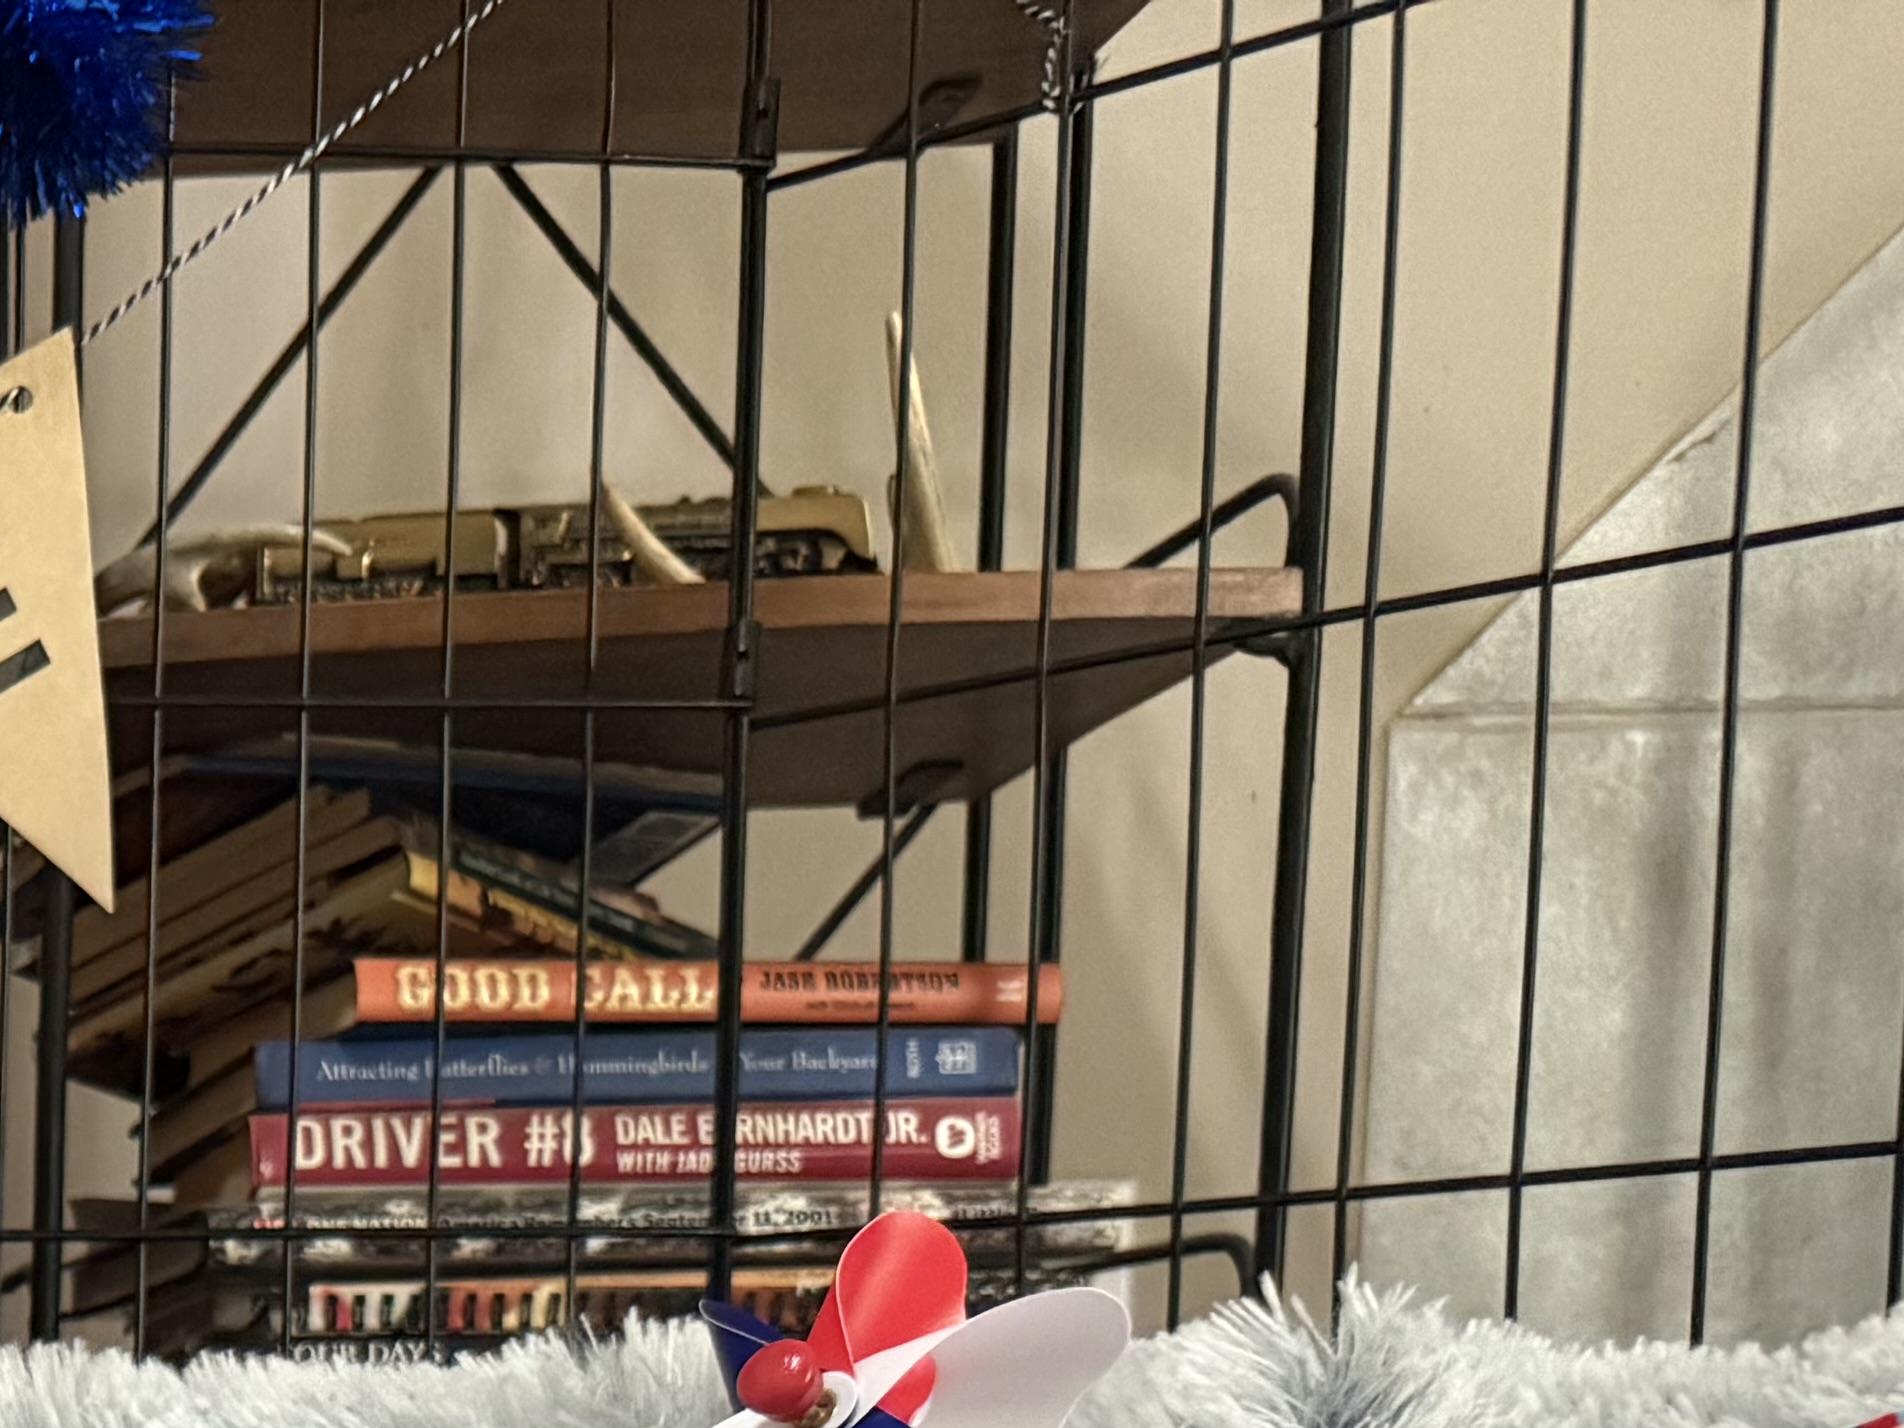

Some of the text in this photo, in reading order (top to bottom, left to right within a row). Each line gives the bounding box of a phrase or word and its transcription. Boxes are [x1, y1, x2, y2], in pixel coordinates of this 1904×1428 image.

[397, 965, 551, 1013] GOOD
[317, 1059, 419, 1082] Attracting
[739, 1051, 786, 1071] Your
[295, 1112, 594, 1171] DRIVER #8
[614, 1109, 928, 1146] DALE ERNHARDT JR.
[616, 1148, 672, 1174] WITH
[675, 1149, 715, 1174] JAD
[522, 1214, 633, 1229] Remmbers
[642, 1212, 745, 1229] Septemr
